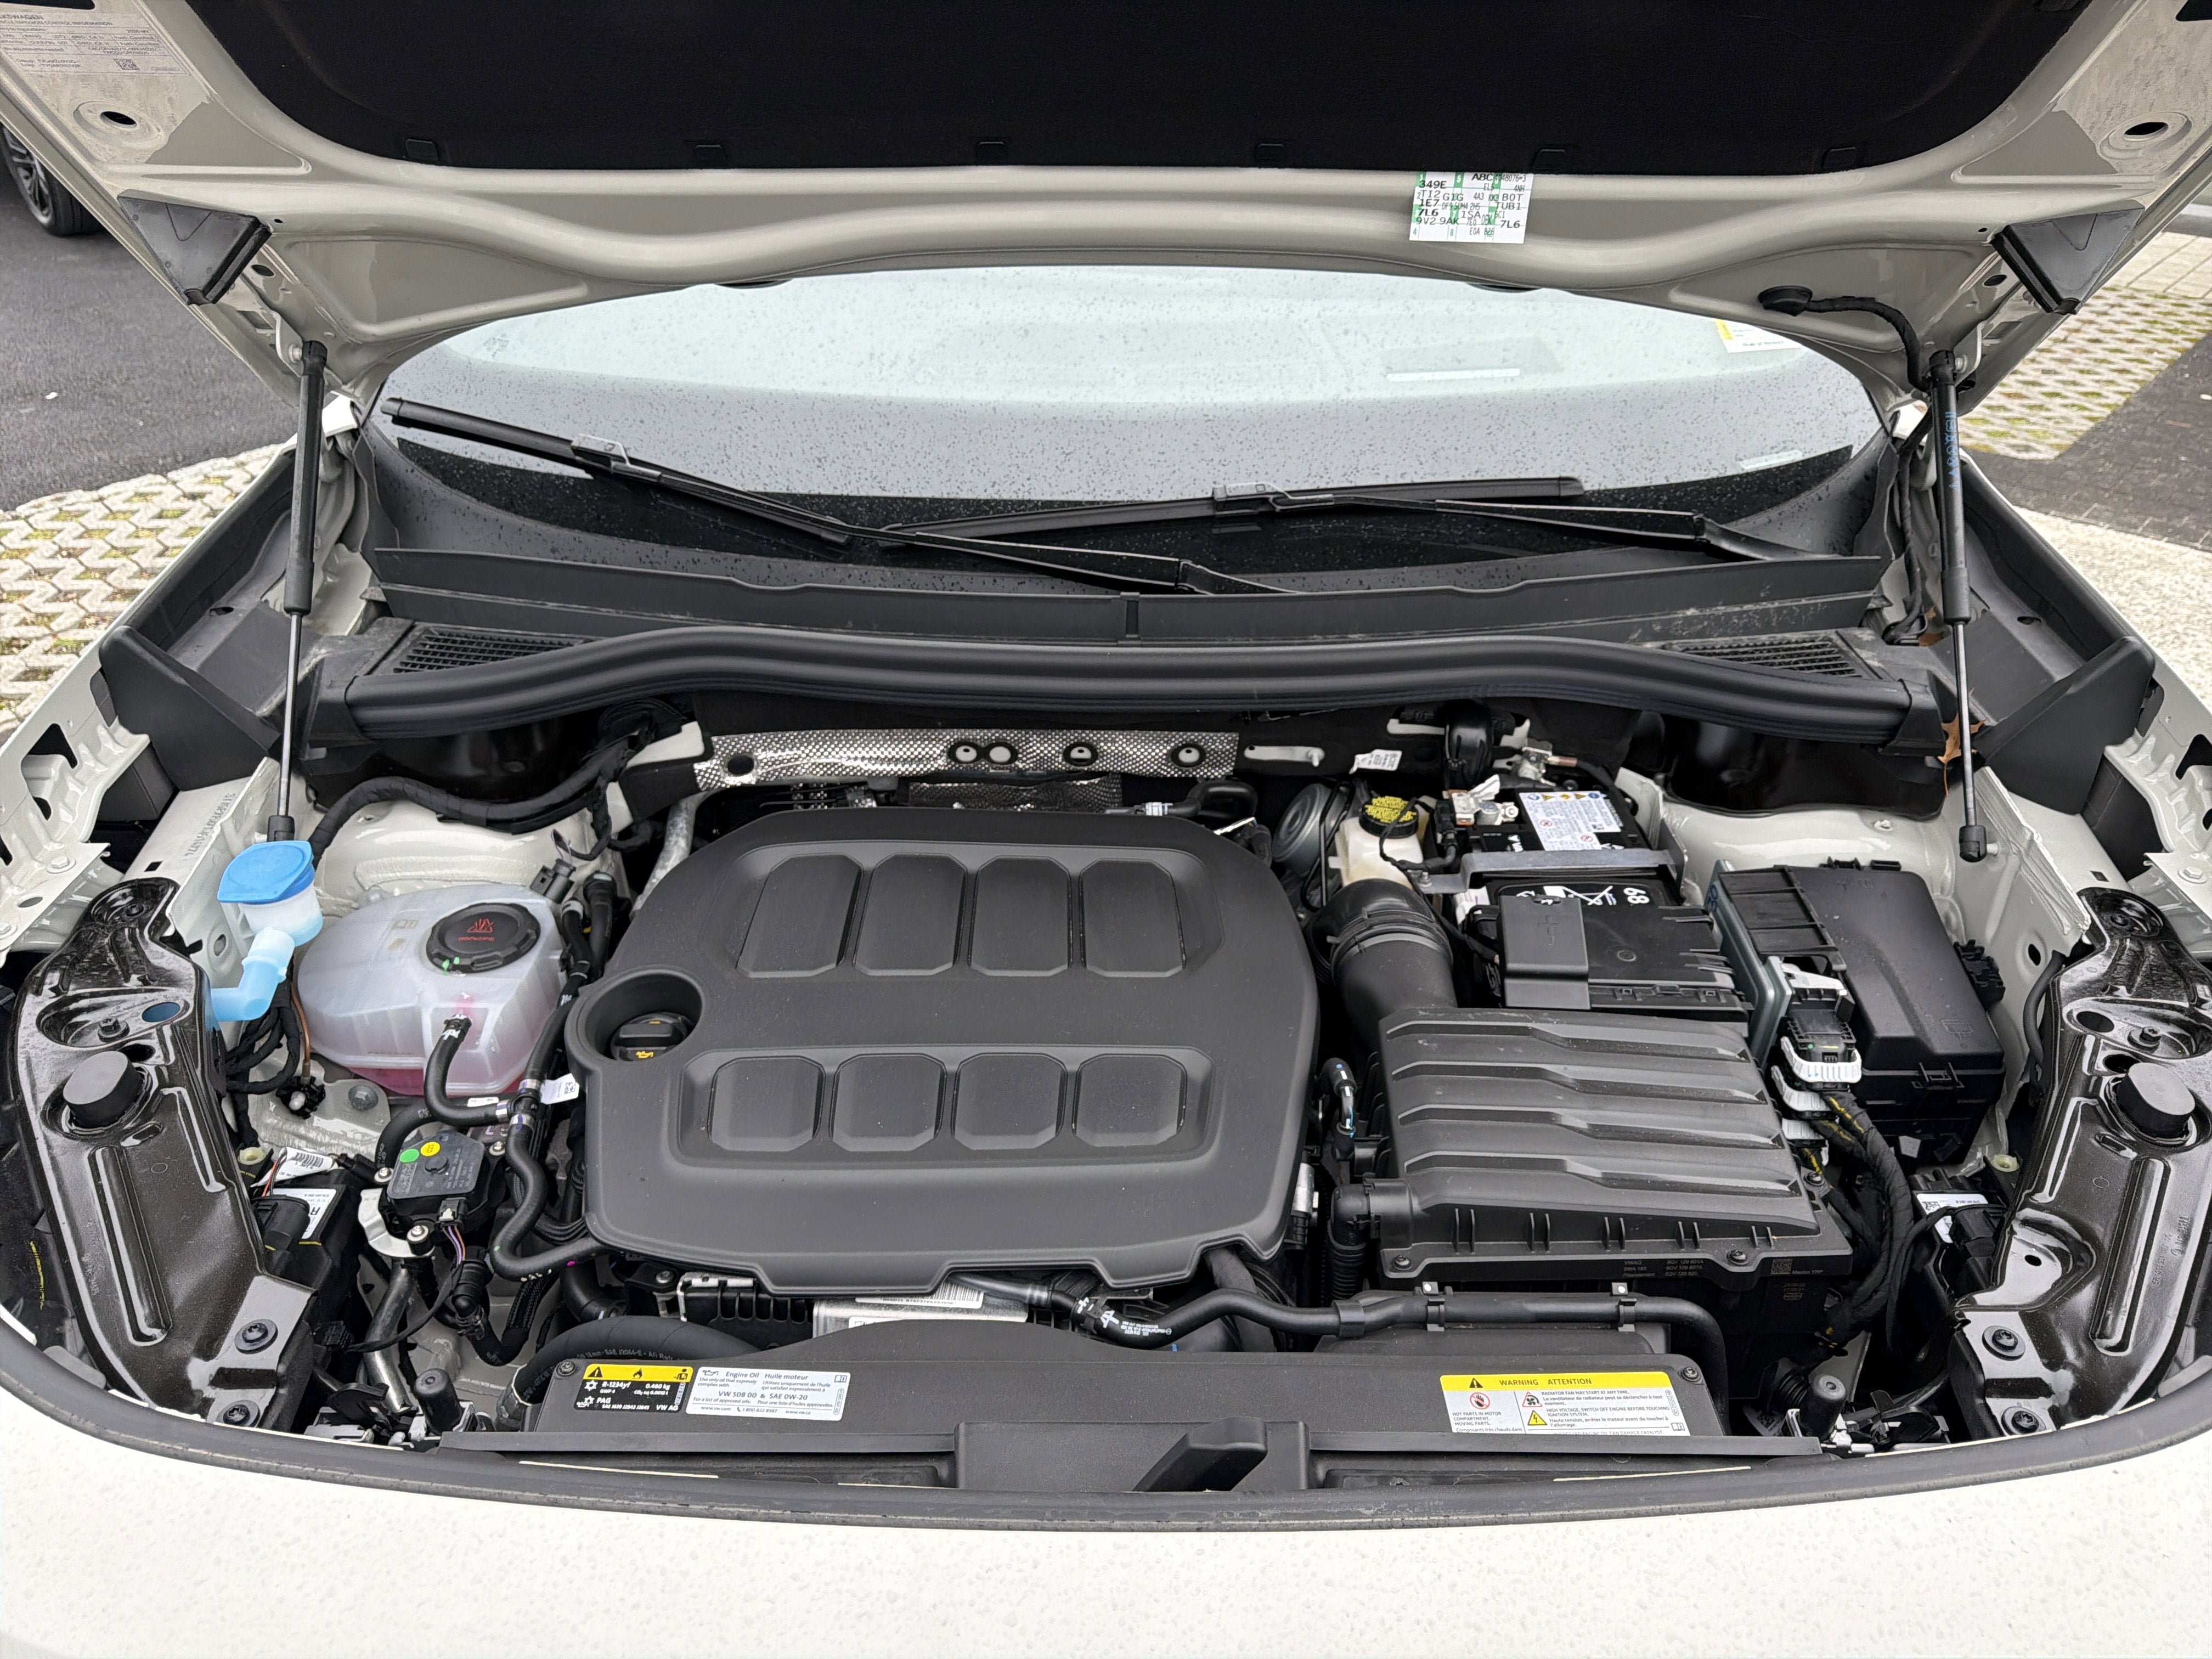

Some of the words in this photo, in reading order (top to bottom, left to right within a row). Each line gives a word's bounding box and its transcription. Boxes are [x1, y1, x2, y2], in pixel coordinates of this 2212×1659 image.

[1419, 180, 1447, 189] 349E
[1419, 199, 1440, 207] 1E7
[1418, 208, 1439, 217] 7L6
[1461, 210, 1481, 219] 1SA
[1416, 217, 1436, 225] 9V2
[1440, 217, 1460, 225] 9AK
[1500, 219, 1521, 229] 7L6
[310, 1207, 321, 1216] R
